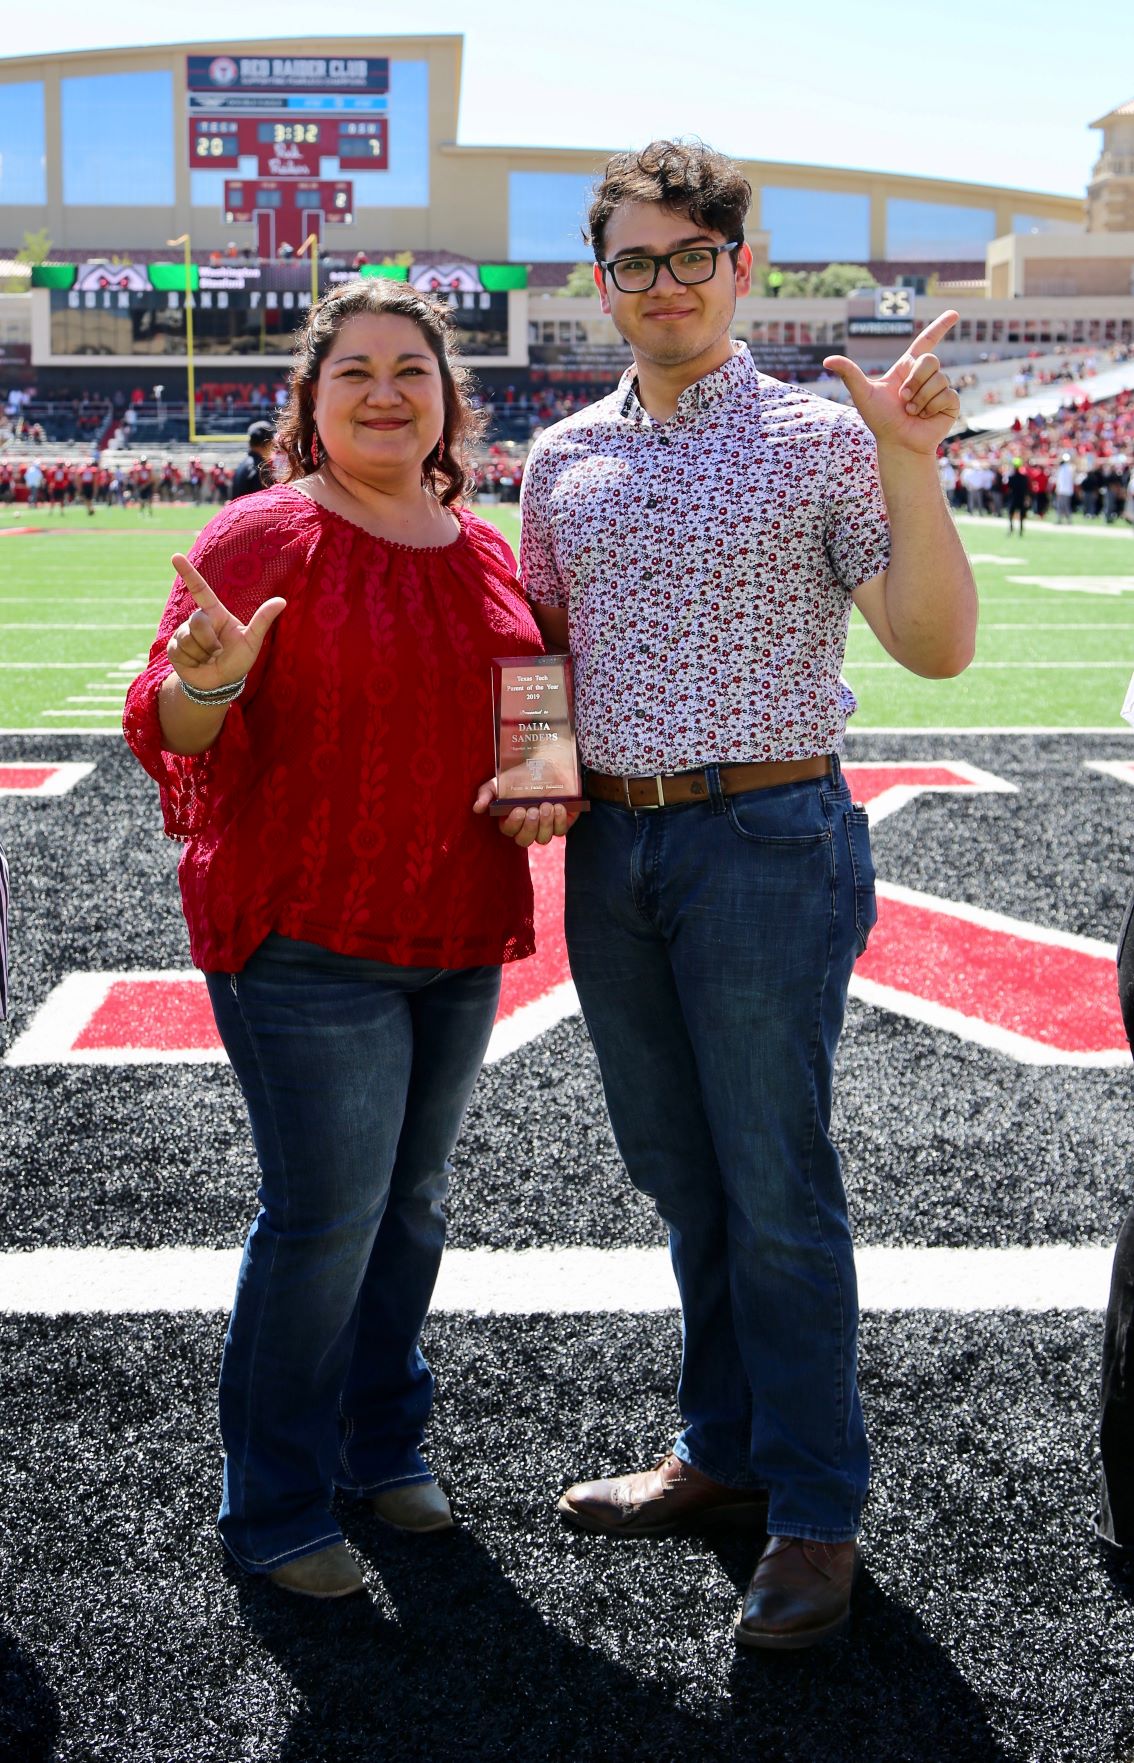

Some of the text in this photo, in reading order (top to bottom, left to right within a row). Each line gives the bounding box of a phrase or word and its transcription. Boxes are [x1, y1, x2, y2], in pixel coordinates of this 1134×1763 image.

[273, 124, 318, 143] 3:32
[197, 137, 224, 156] 20
[368, 139, 380, 156] 7
[168, 292, 230, 309] BAND
[250, 292, 312, 310] FROM
[880, 291, 911, 317] 25
[535, 674, 549, 682] Tech
[518, 722, 551, 732] DALIA
[511, 732, 558, 743] SANDERS
